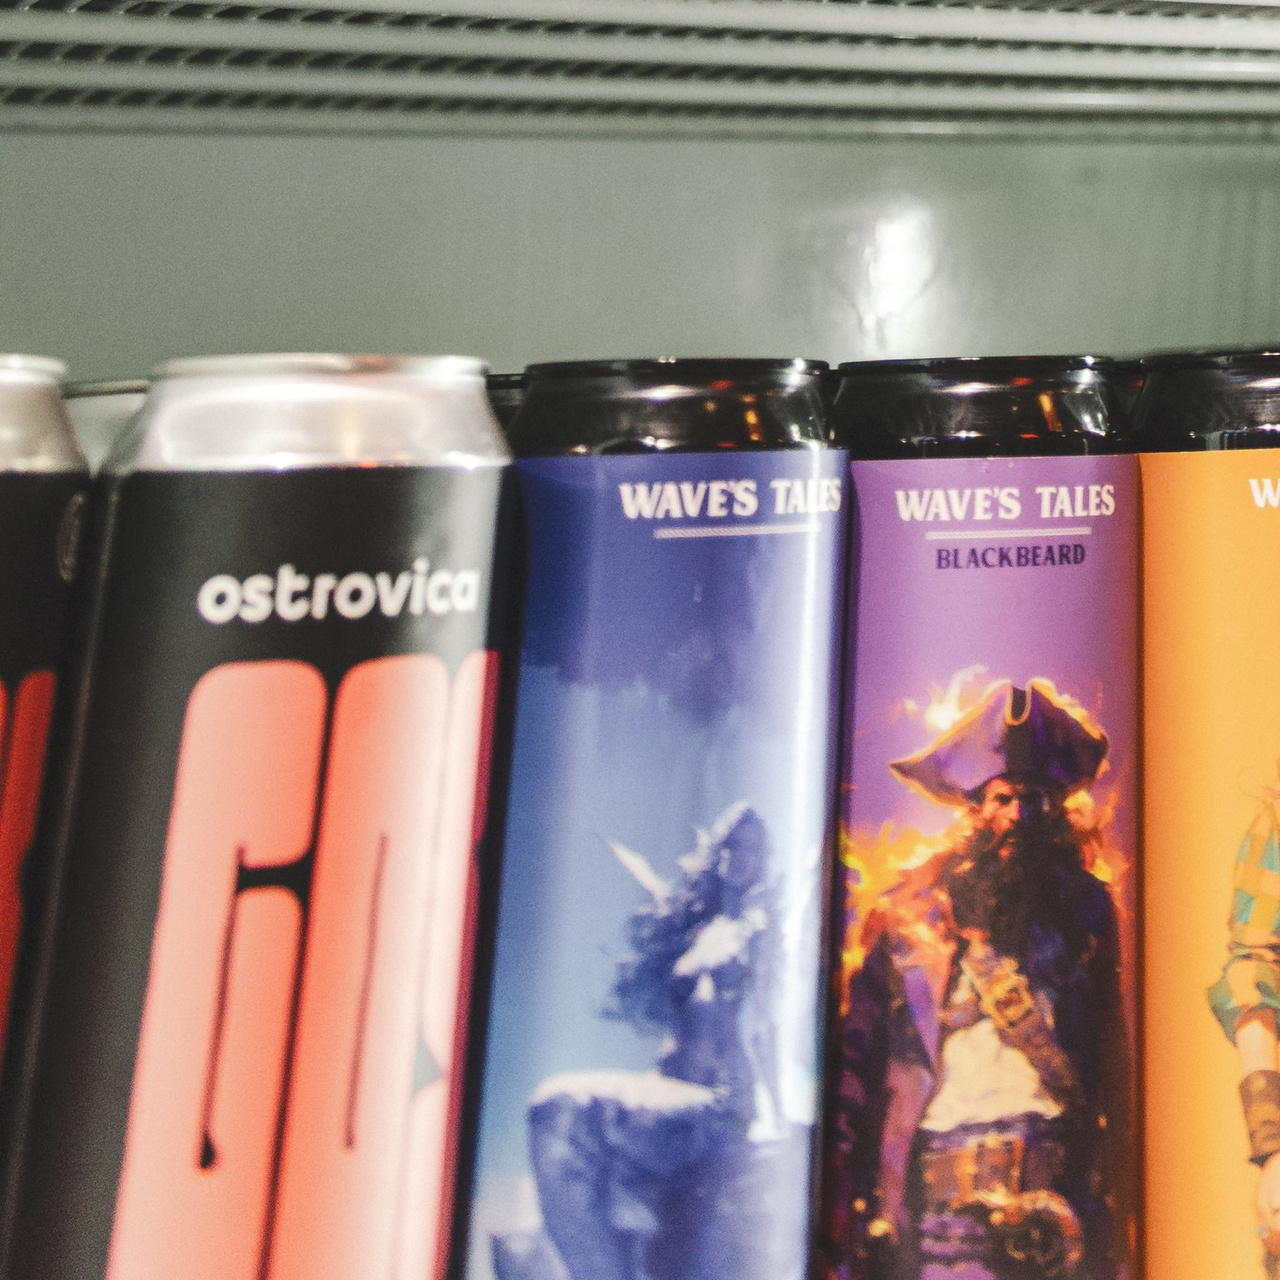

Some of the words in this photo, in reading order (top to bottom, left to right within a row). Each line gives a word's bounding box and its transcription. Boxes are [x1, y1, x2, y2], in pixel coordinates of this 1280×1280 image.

[619, 479, 758, 520] WAVE'S
[894, 488, 1022, 522] WAVE'S
[1035, 484, 1116, 520] TALES
[935, 545, 1086, 570] BLACKBEARD
[197, 556, 482, 624] ostrovica
